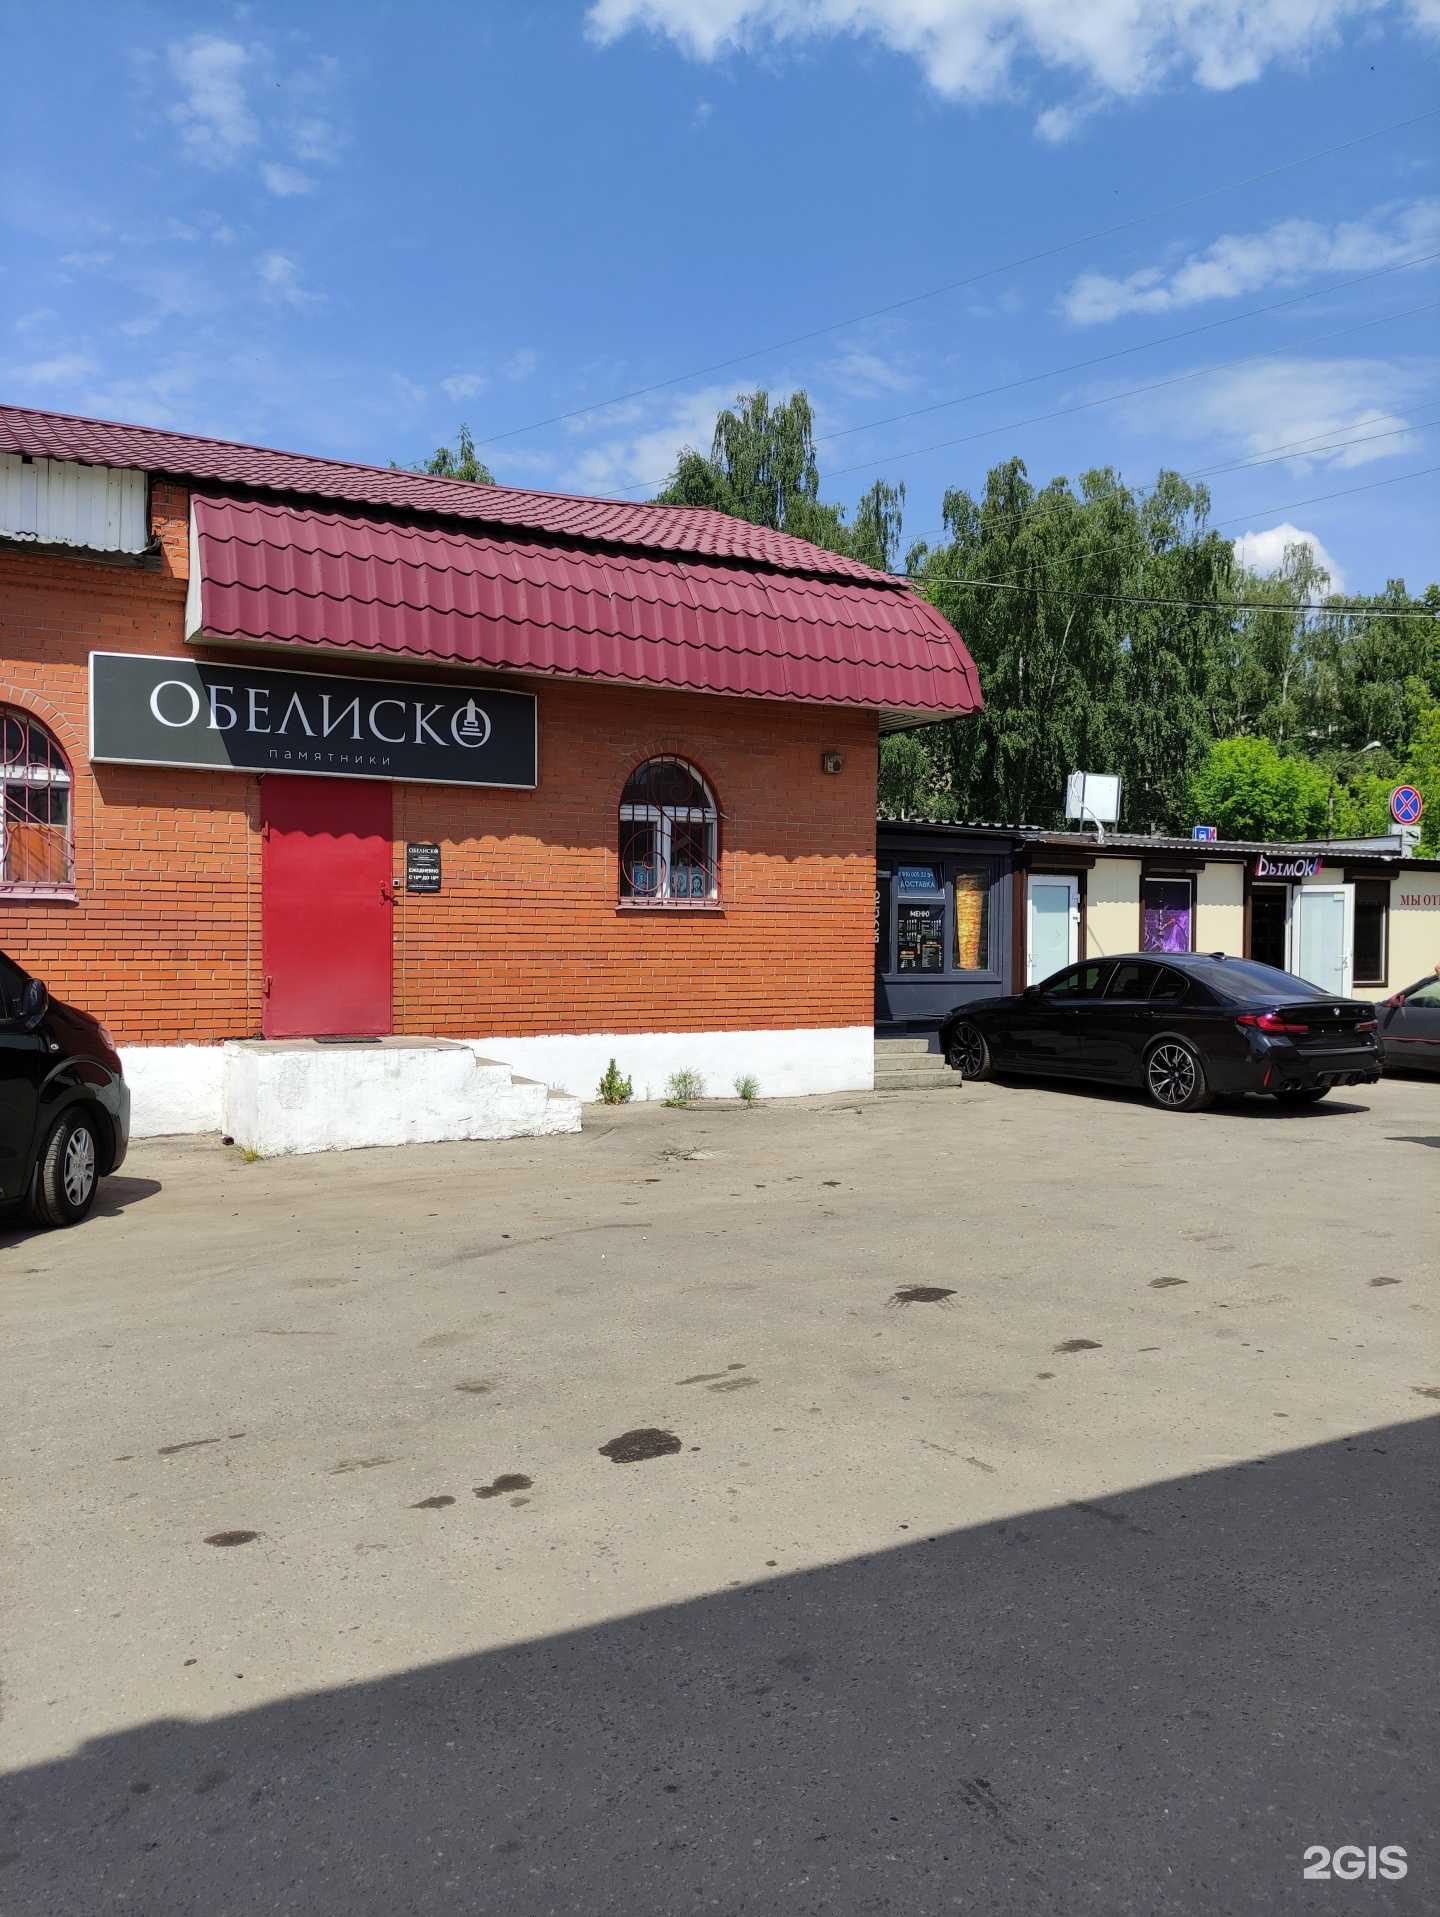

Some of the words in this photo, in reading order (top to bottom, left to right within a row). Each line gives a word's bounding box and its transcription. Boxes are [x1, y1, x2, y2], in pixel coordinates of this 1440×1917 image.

[268, 748, 392, 767] памятники
[900, 880, 936, 889] ДОСТАВКА
[1400, 894, 1422, 906] МЫ
[1423, 894, 1440, 906] ОТ
[909, 910, 930, 918] МЕНЮ
